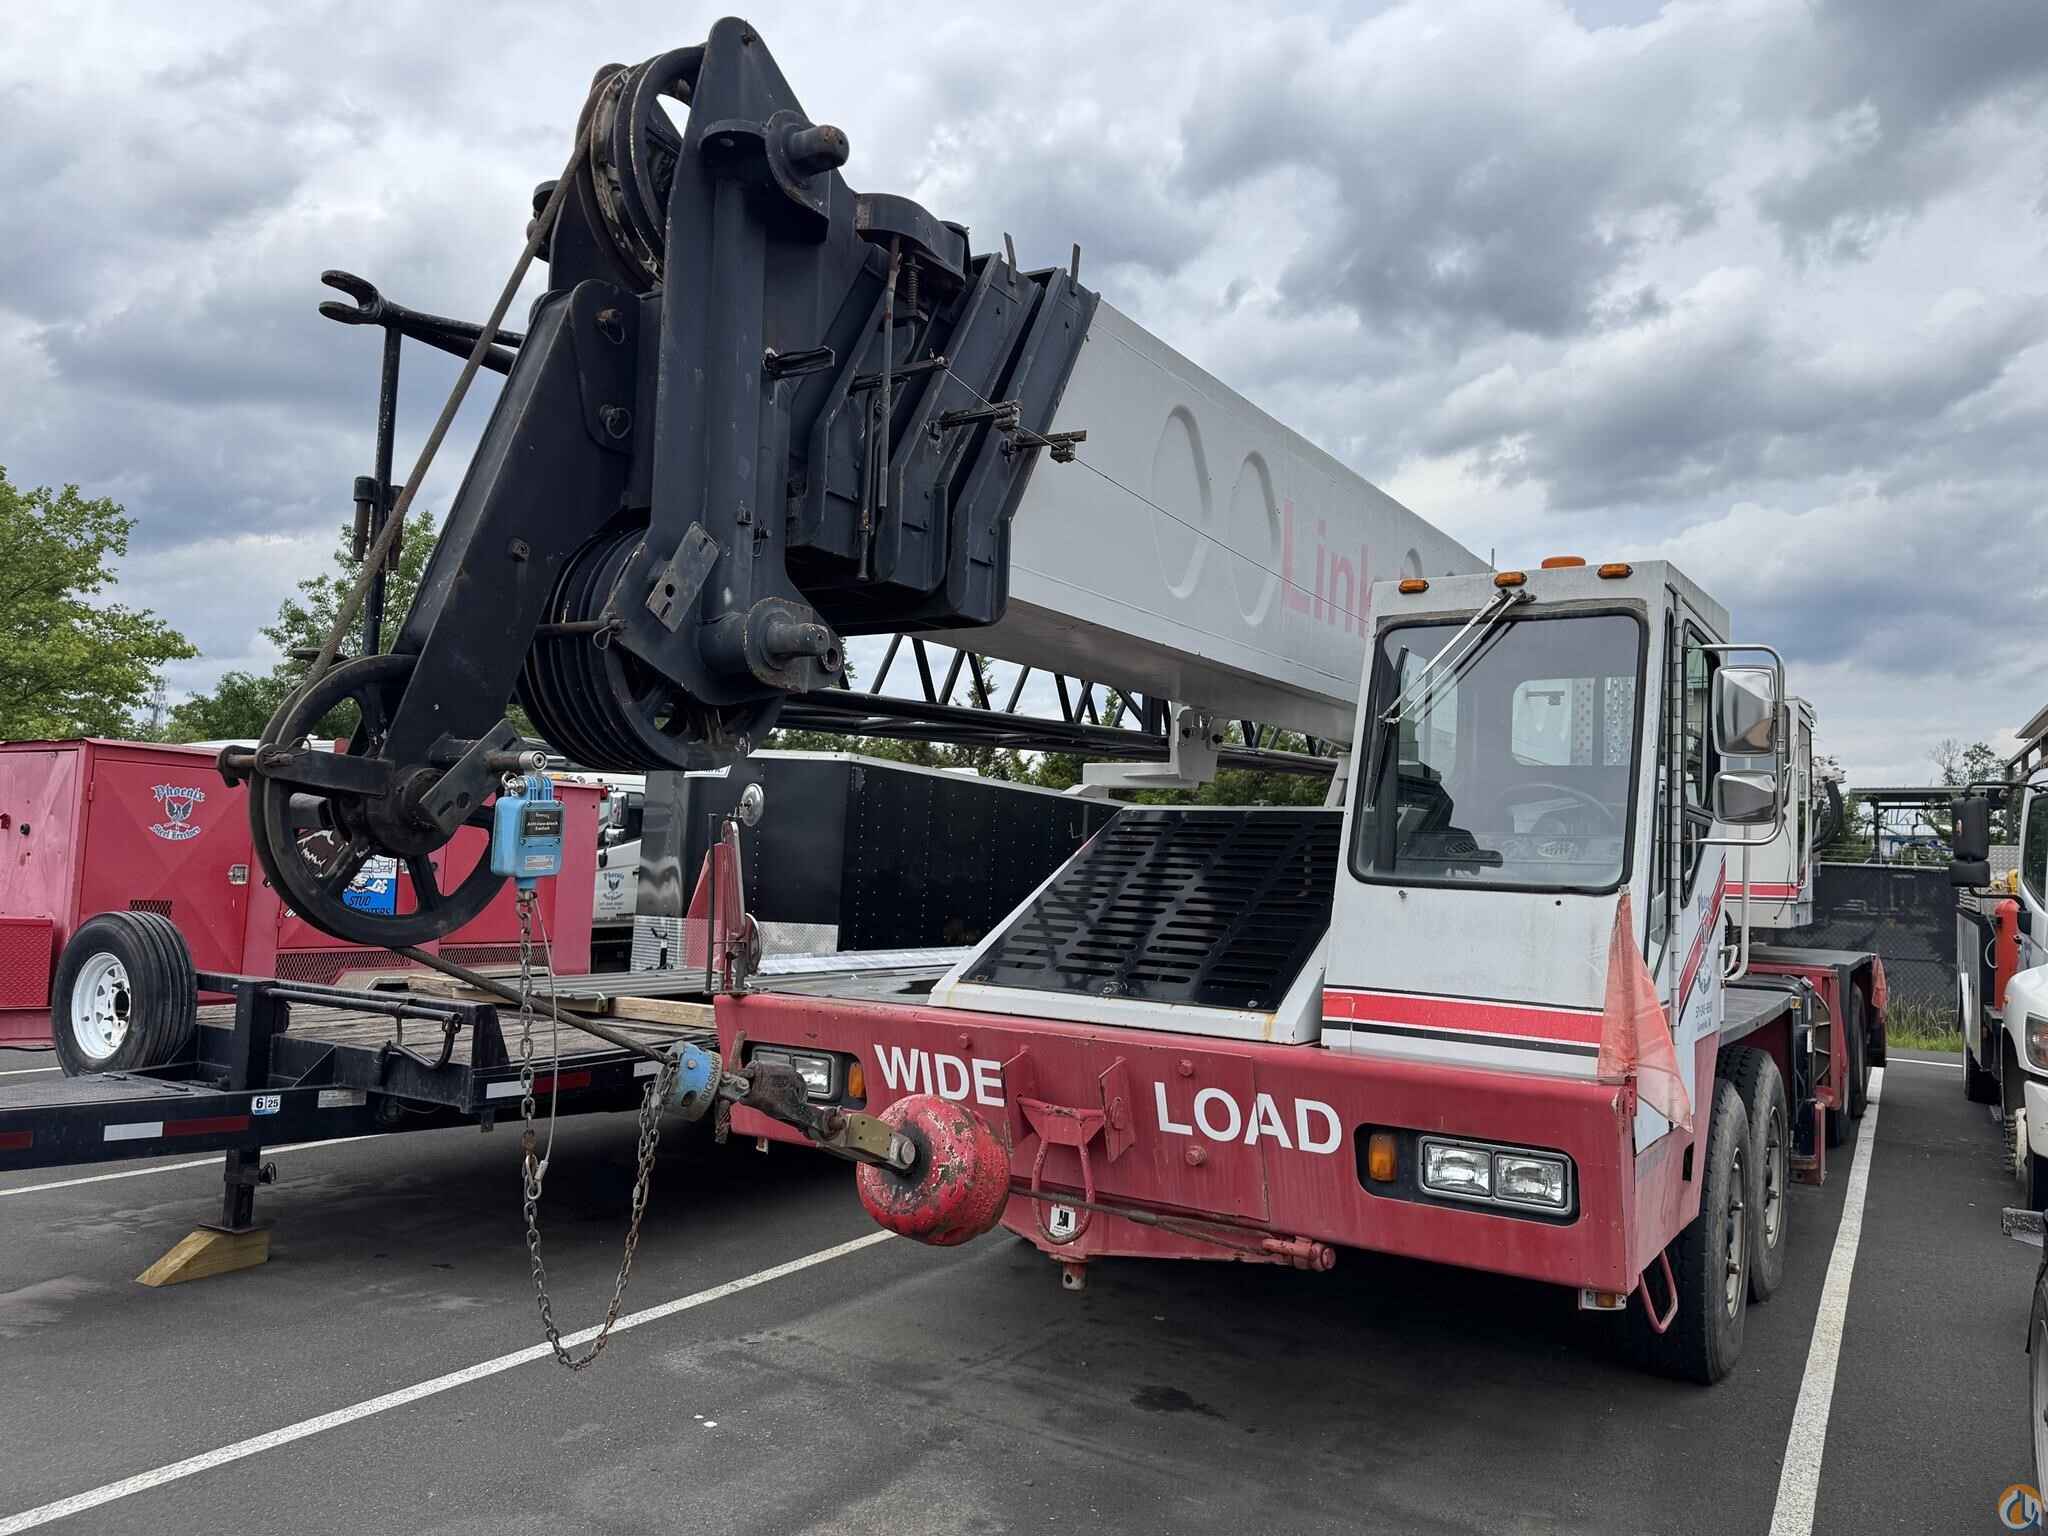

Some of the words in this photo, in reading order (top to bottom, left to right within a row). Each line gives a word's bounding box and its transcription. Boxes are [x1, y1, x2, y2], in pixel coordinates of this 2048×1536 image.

[151, 783, 205, 802] Phoenix
[349, 895, 371, 906] STUD
[255, 1097, 264, 1109] 6
[267, 1098, 279, 1109] 25
[873, 1044, 1005, 1108] WIDE
[1153, 1081, 1342, 1154] LOAD
